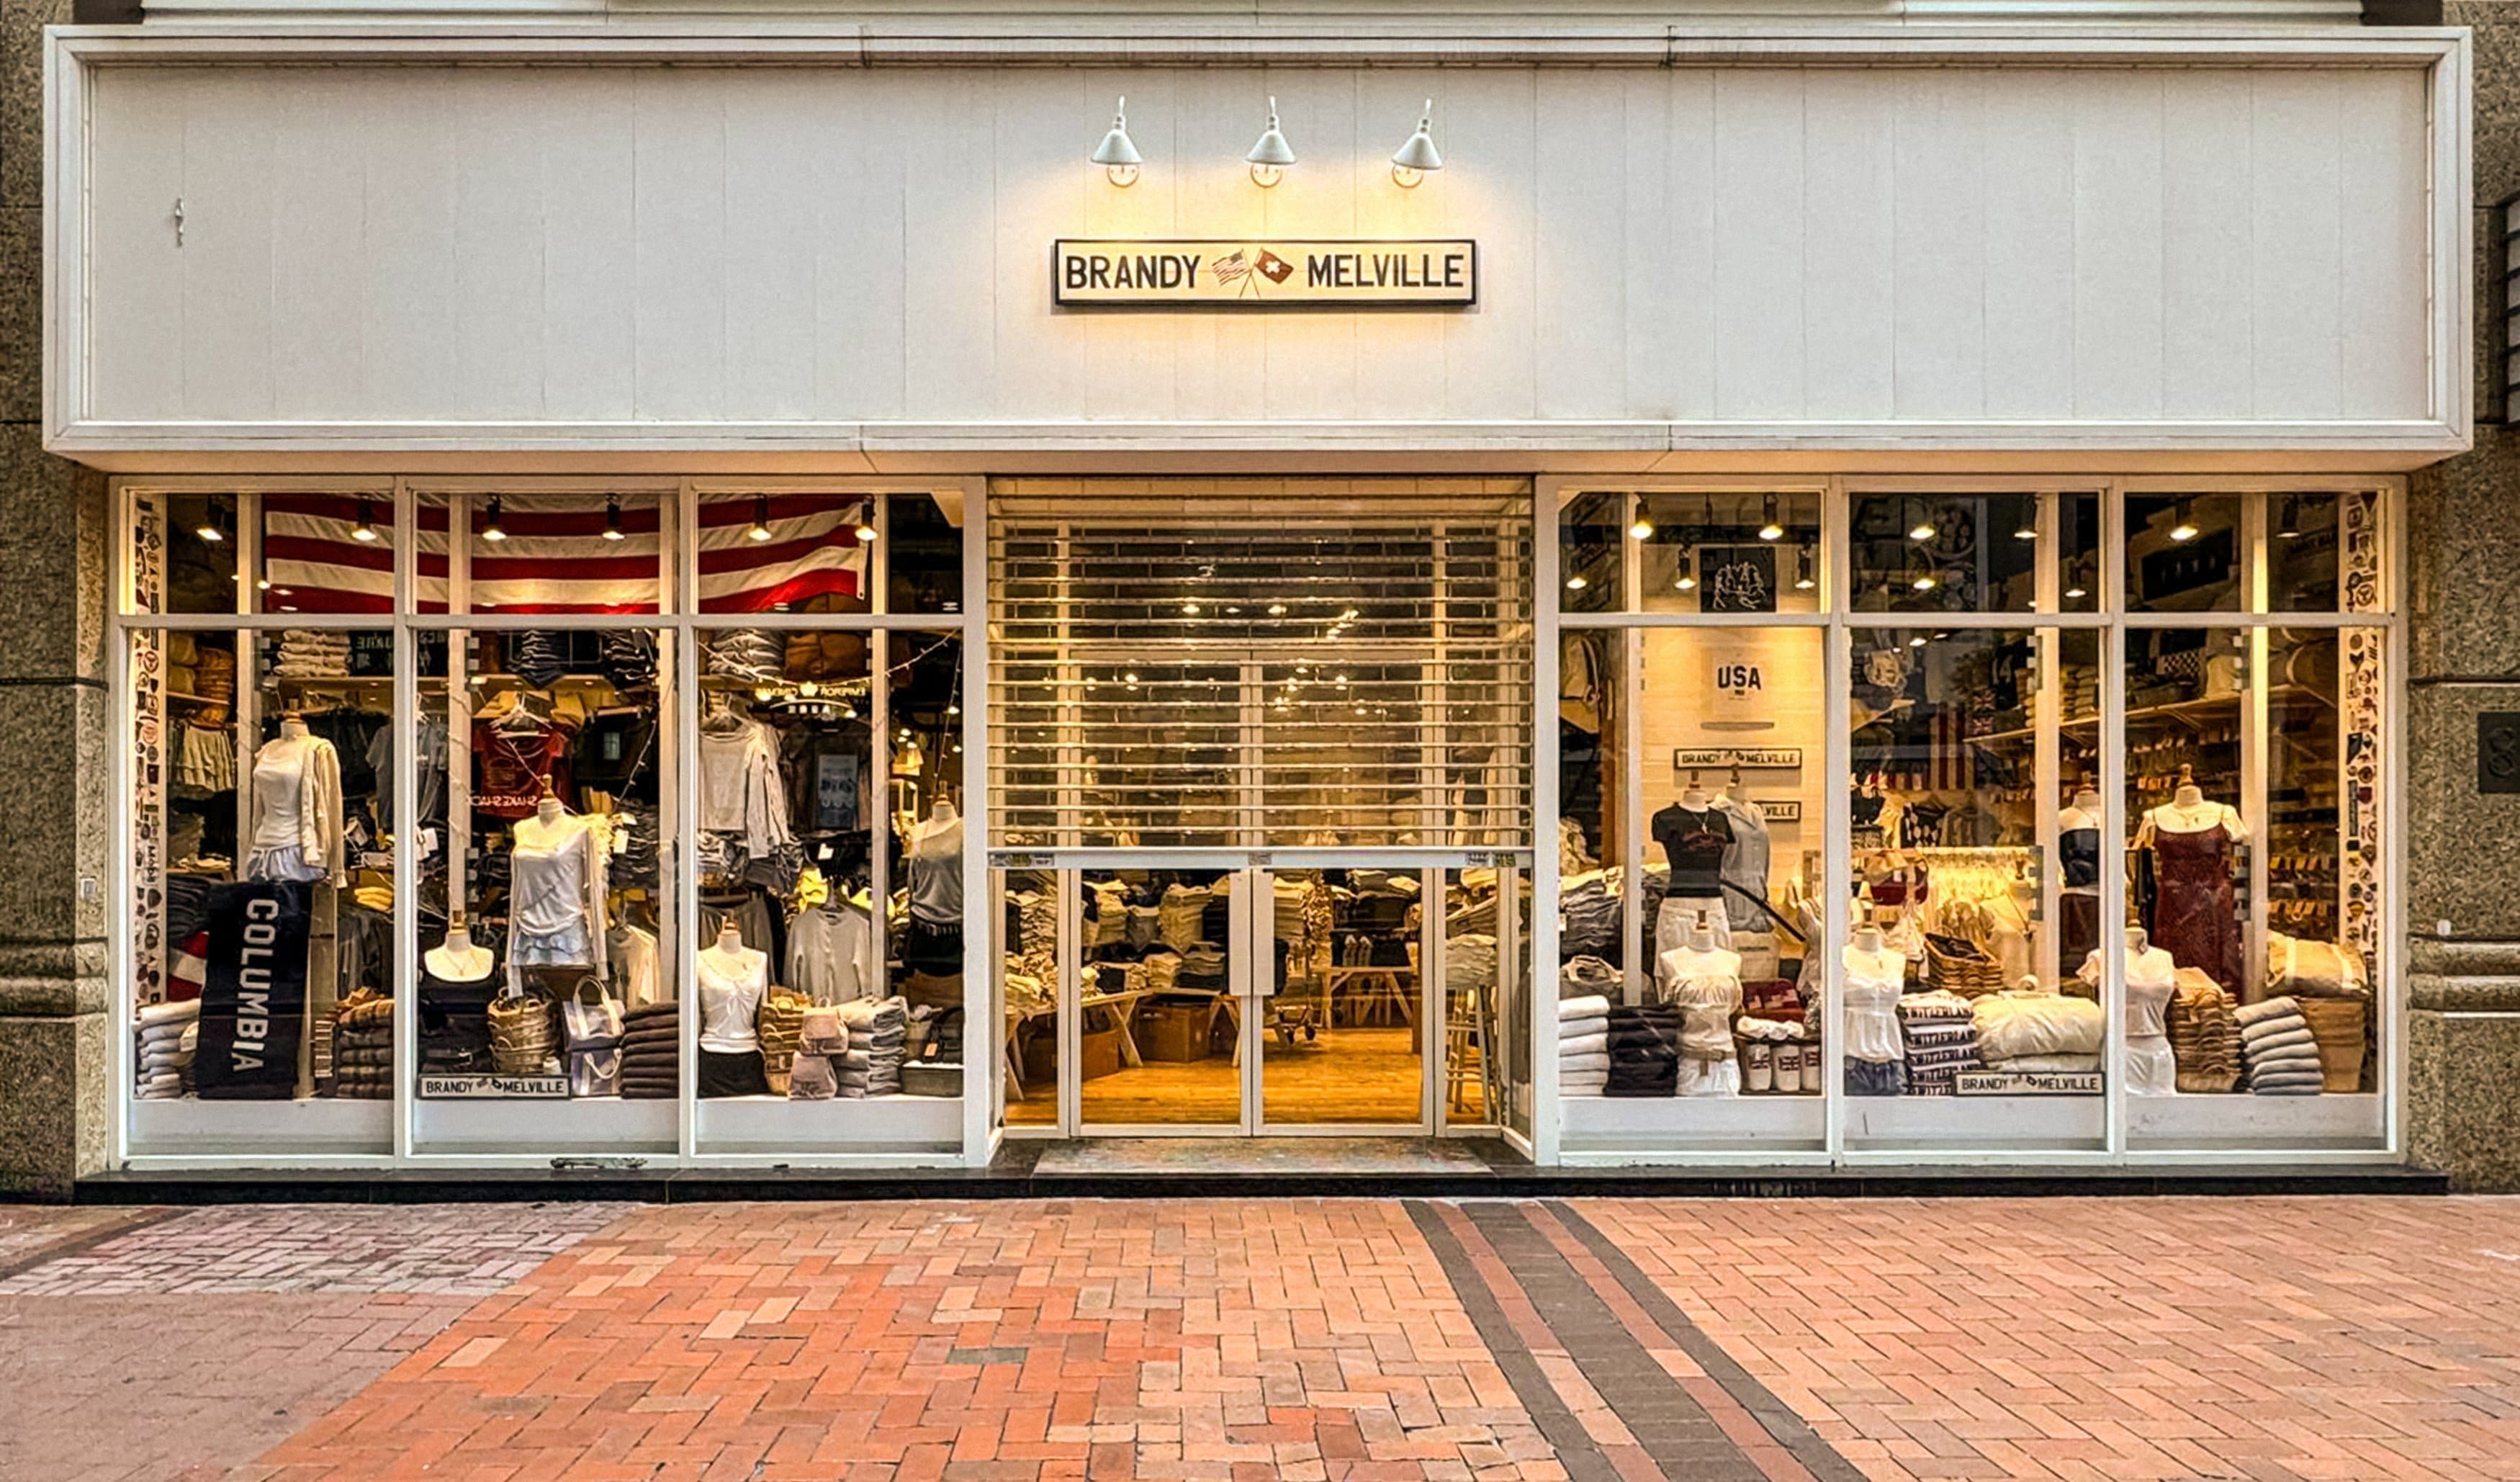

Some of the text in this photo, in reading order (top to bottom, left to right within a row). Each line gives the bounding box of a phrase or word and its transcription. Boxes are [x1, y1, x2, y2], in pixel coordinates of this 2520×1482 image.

[1066, 253, 1464, 289] BRANDY MELVILLE
[1718, 665, 1762, 690] USA
[1681, 753, 1796, 764] BRANDY MELVILLE
[1764, 806, 1796, 817] VILLE
[231, 899, 280, 1072] COLUMBIA
[426, 1081, 564, 1093] BRANDY MELVILLE
[1961, 1078, 2099, 1090] BRANDY MELVILLE
